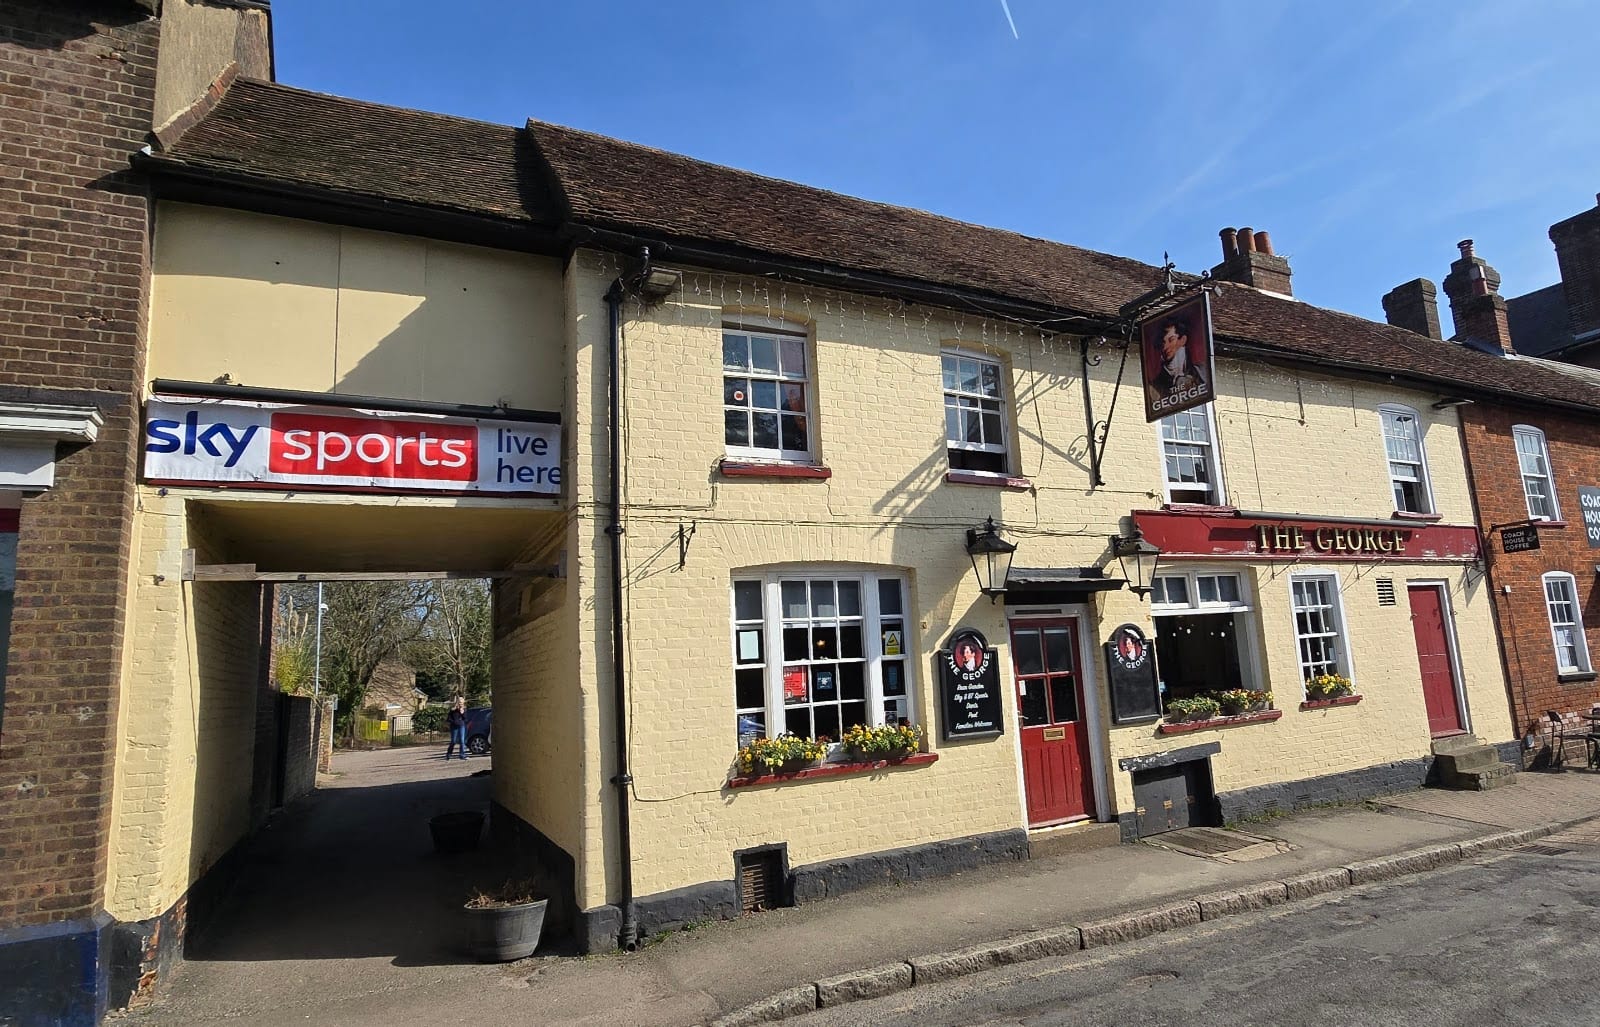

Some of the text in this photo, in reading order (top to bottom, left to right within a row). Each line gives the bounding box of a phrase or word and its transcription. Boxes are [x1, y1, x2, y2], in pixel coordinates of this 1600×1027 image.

[1152, 383, 1208, 411] GEORGE
[1169, 383, 1186, 394] THE
[146, 410, 467, 471] sky sports
[497, 428, 548, 455] live
[497, 458, 560, 484] here
[1255, 525, 1405, 551] THE GEORGE
[1503, 530, 1525, 539] COACH
[1504, 537, 1525, 545] HOUSE
[1505, 542, 1530, 551] COFFEE
[1588, 526, 1600, 541] CO
[947, 652, 990, 680] THE GEORGE
[1113, 643, 1148, 669] THE GEORGE
